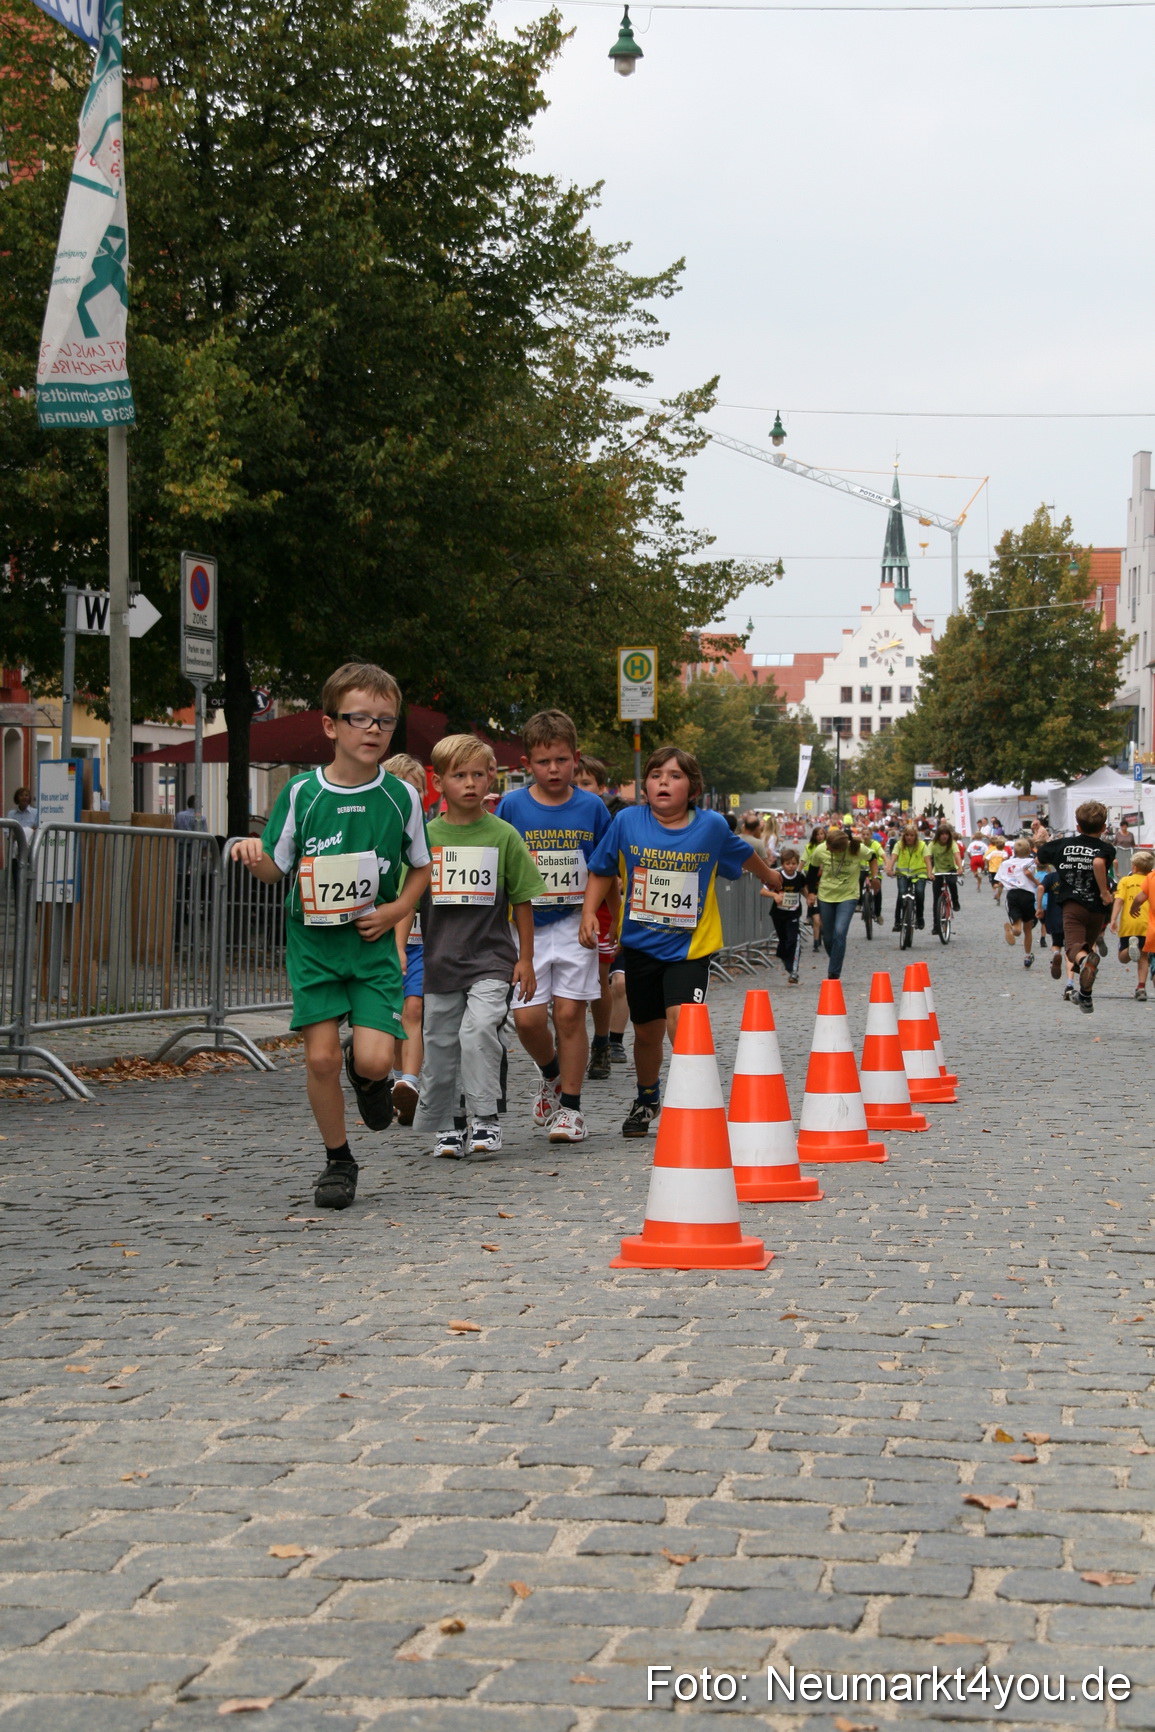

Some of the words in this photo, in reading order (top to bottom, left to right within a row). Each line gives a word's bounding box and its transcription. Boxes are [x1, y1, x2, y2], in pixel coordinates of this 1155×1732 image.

[192, 612, 208, 626] ZONE
[631, 660, 644, 676] H
[337, 805, 366, 814] DERBYSTAR
[305, 831, 343, 856] Sport
[445, 851, 457, 862] Uli
[538, 855, 579, 866] Sebastian
[629, 845, 641, 856] 10.
[643, 848, 710, 862] NEUMARKTER
[640, 858, 698, 872] STADTLAUF
[446, 869, 491, 886] 7103
[540, 871, 579, 887] 7141
[650, 874, 670, 886] Léon
[318, 879, 372, 903] 7242
[650, 891, 692, 909] 7194
